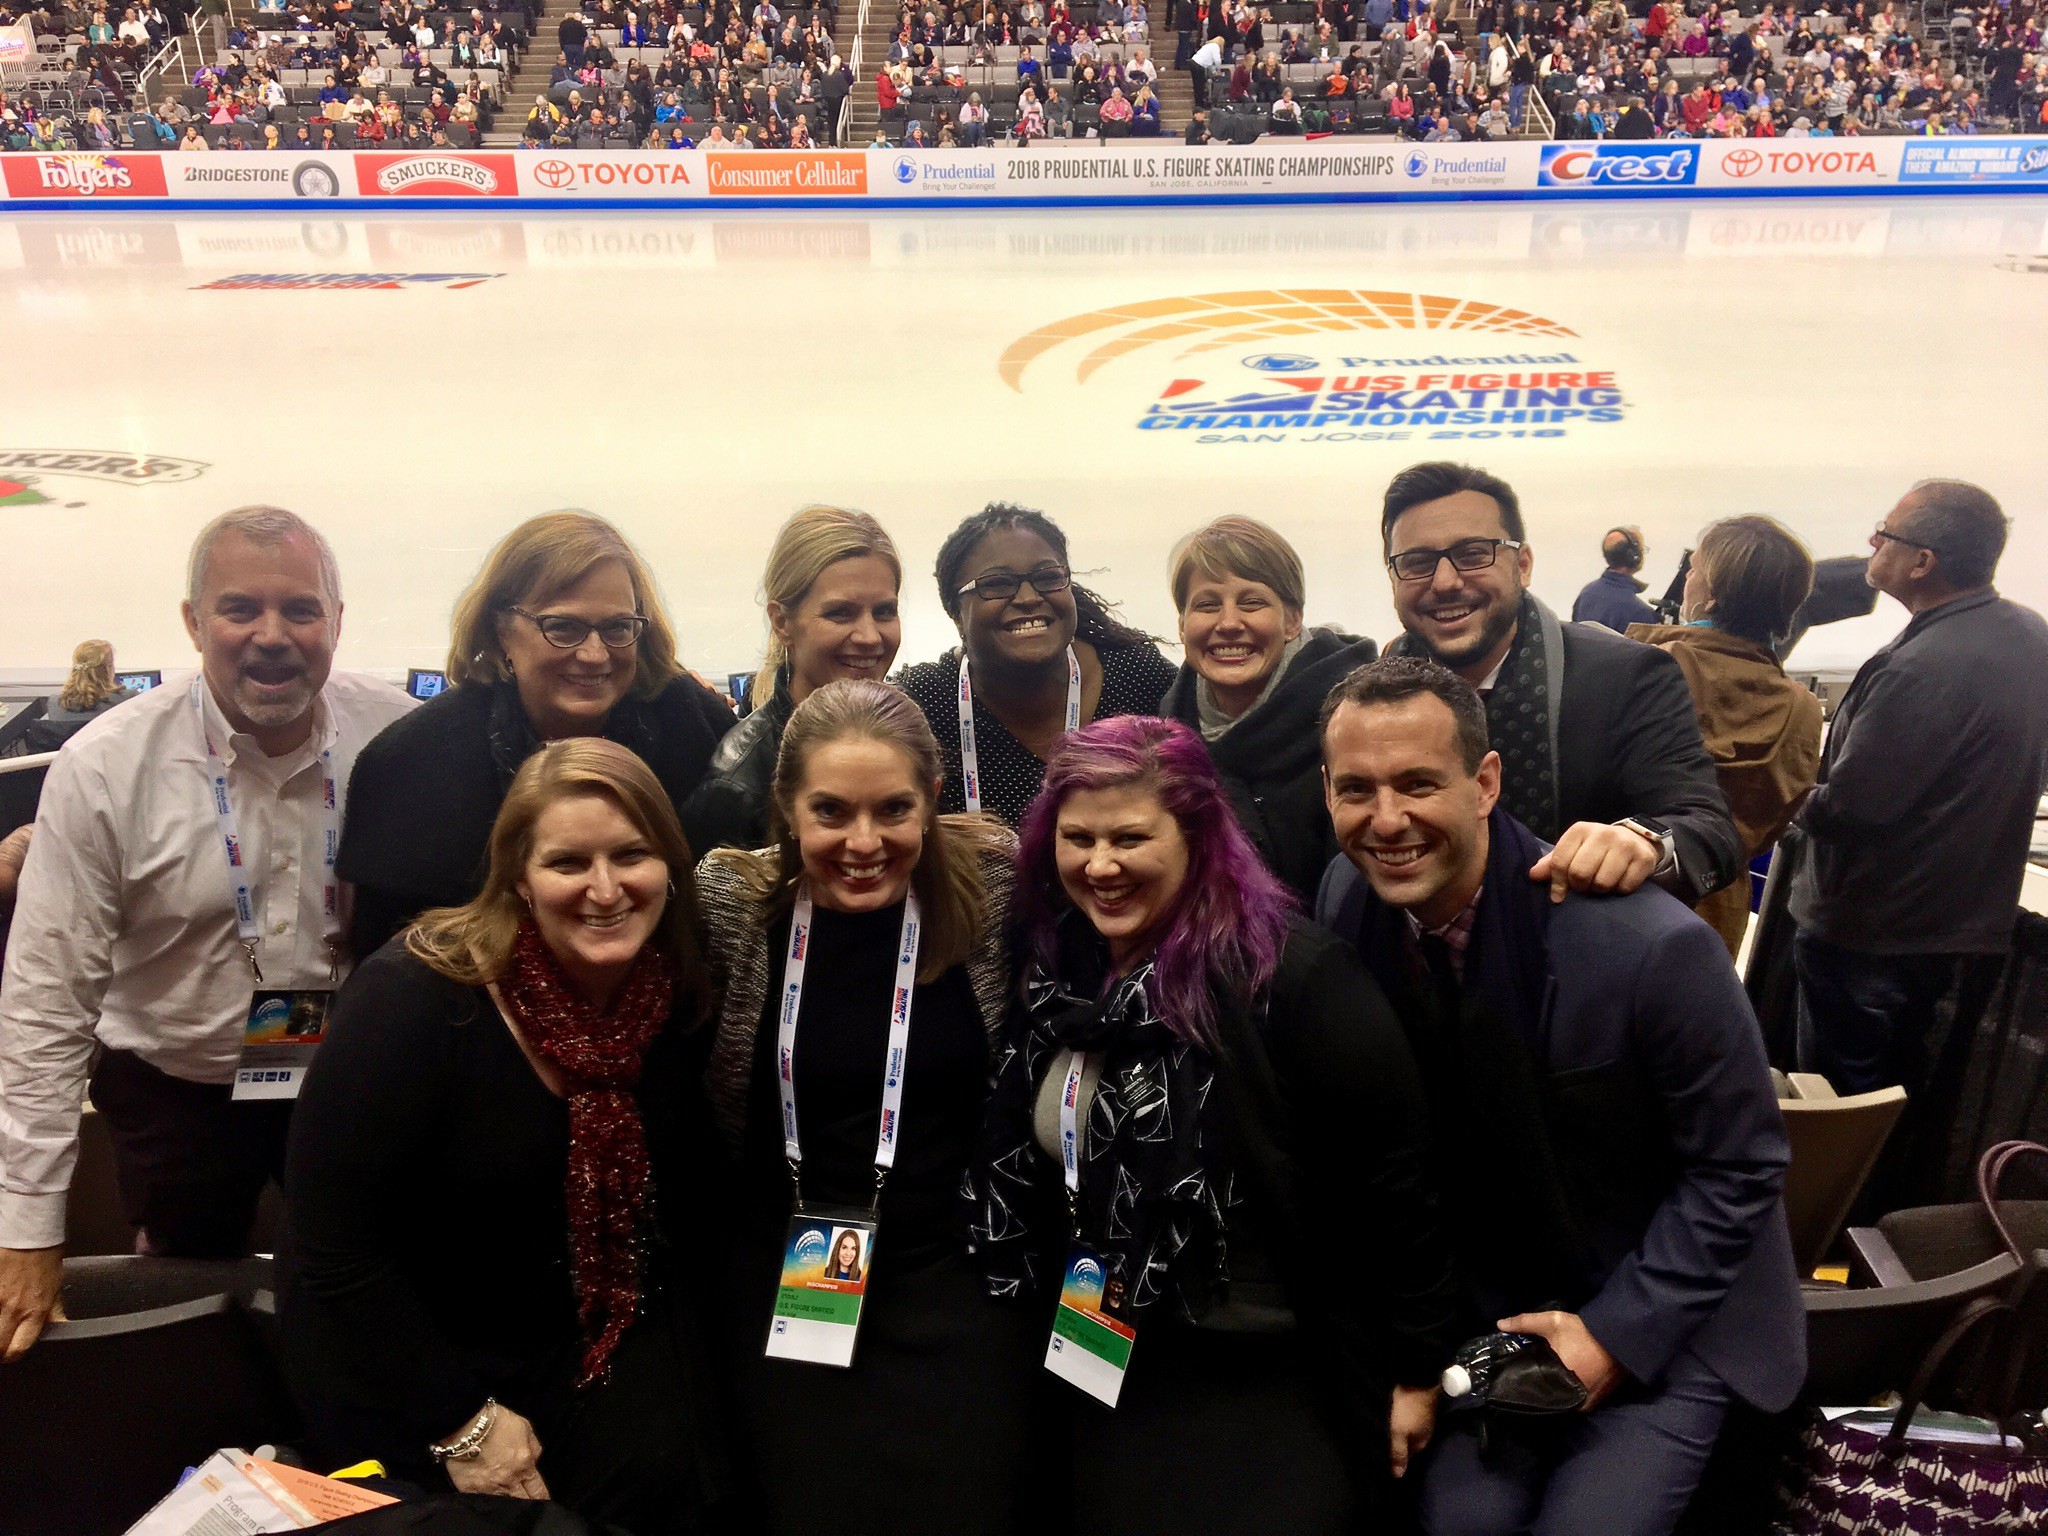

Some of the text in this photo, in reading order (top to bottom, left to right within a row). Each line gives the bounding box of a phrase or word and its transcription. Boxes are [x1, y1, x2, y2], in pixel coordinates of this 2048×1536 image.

[1433, 157, 1507, 173] Prudential
[1550, 149, 1693, 181] Crest
[1768, 151, 1877, 174] TOYOTA
[1906, 147, 2022, 160] OFFICIAL ALMONDMILK OF
[2020, 148, 2048, 172] Sil
[36, 157, 132, 195] Folgers
[184, 167, 289, 182] BRIDGESTONE
[386, 160, 487, 186] SMUCKER'S
[577, 163, 690, 184] TOYOTA
[710, 160, 860, 187] Consumer Cellular
[922, 163, 996, 179] Prudential
[1007, 156, 1394, 179] 2018 PRUDENTIAL U.S. FIGURE SKATING CHAMPIONSHIPS
[1904, 160, 2019, 174] THESE AMAZING HUMANS
[922, 182, 996, 191] Bring Your Challenges
[1431, 176, 1506, 186] Bring Your Challenges
[1337, 352, 1583, 368] Prudential
[1331, 371, 1617, 393] US FIGURE
[1322, 387, 1624, 411] SKATING
[1136, 406, 1625, 431] CHAMPIONSHIPS
[1195, 429, 1567, 444] SAN JOSE 2018
[904, 923, 913, 953] Prudential
[787, 994, 796, 1024] Prudential
[900, 988, 909, 1012] SKATING
[890, 1048, 899, 1077] Prudential
[222, 1494, 257, 1529] Program
